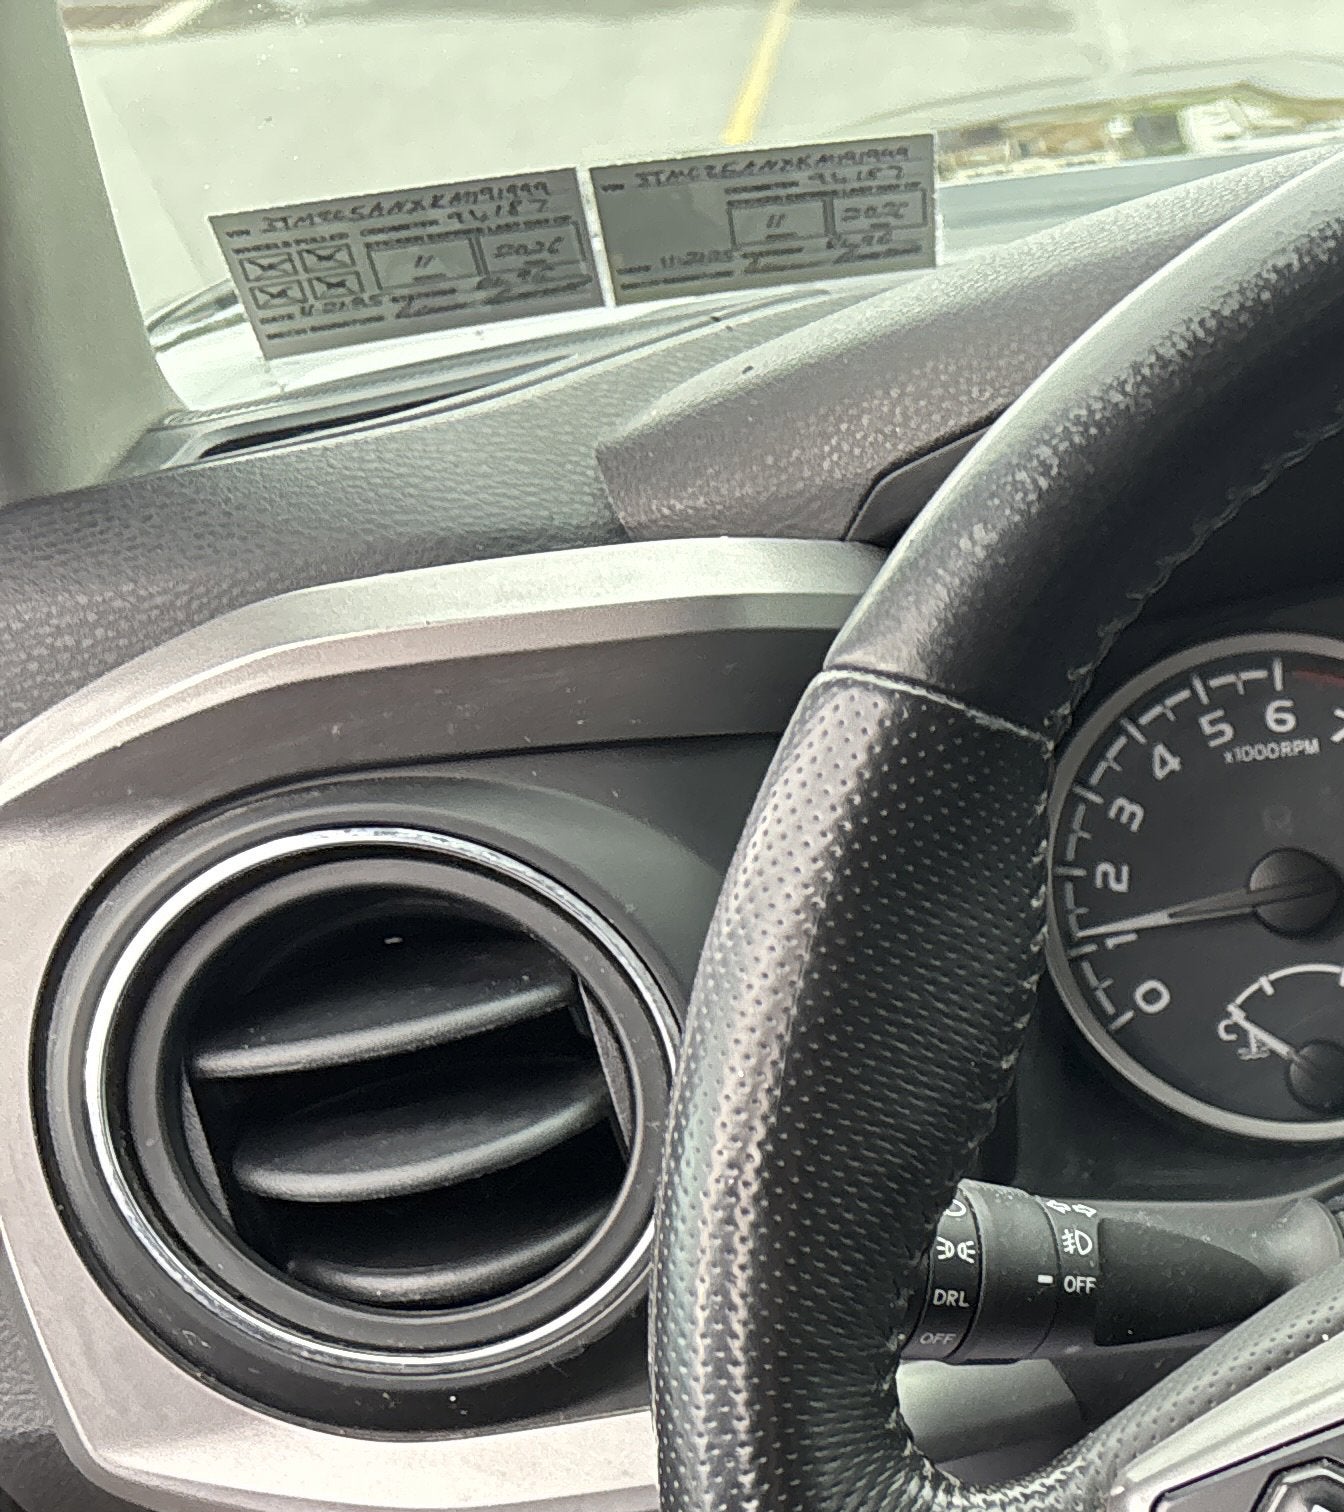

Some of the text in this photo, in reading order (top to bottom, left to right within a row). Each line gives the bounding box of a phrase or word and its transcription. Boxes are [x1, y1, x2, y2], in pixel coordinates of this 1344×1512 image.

[1199, 709, 1235, 748] 5
[1265, 700, 1297, 734] 6
[1150, 745, 1182, 781] 4
[1108, 800, 1144, 832] 3
[1095, 863, 1129, 893] 2
[1104, 932, 1138, 950] 1
[1133, 978, 1171, 1015] 0
[1217, 1019, 1238, 1041] C
[933, 1288, 970, 1309] DRL
[1063, 1275, 1097, 1295] OFF
[919, 1332, 956, 1346] OFF
